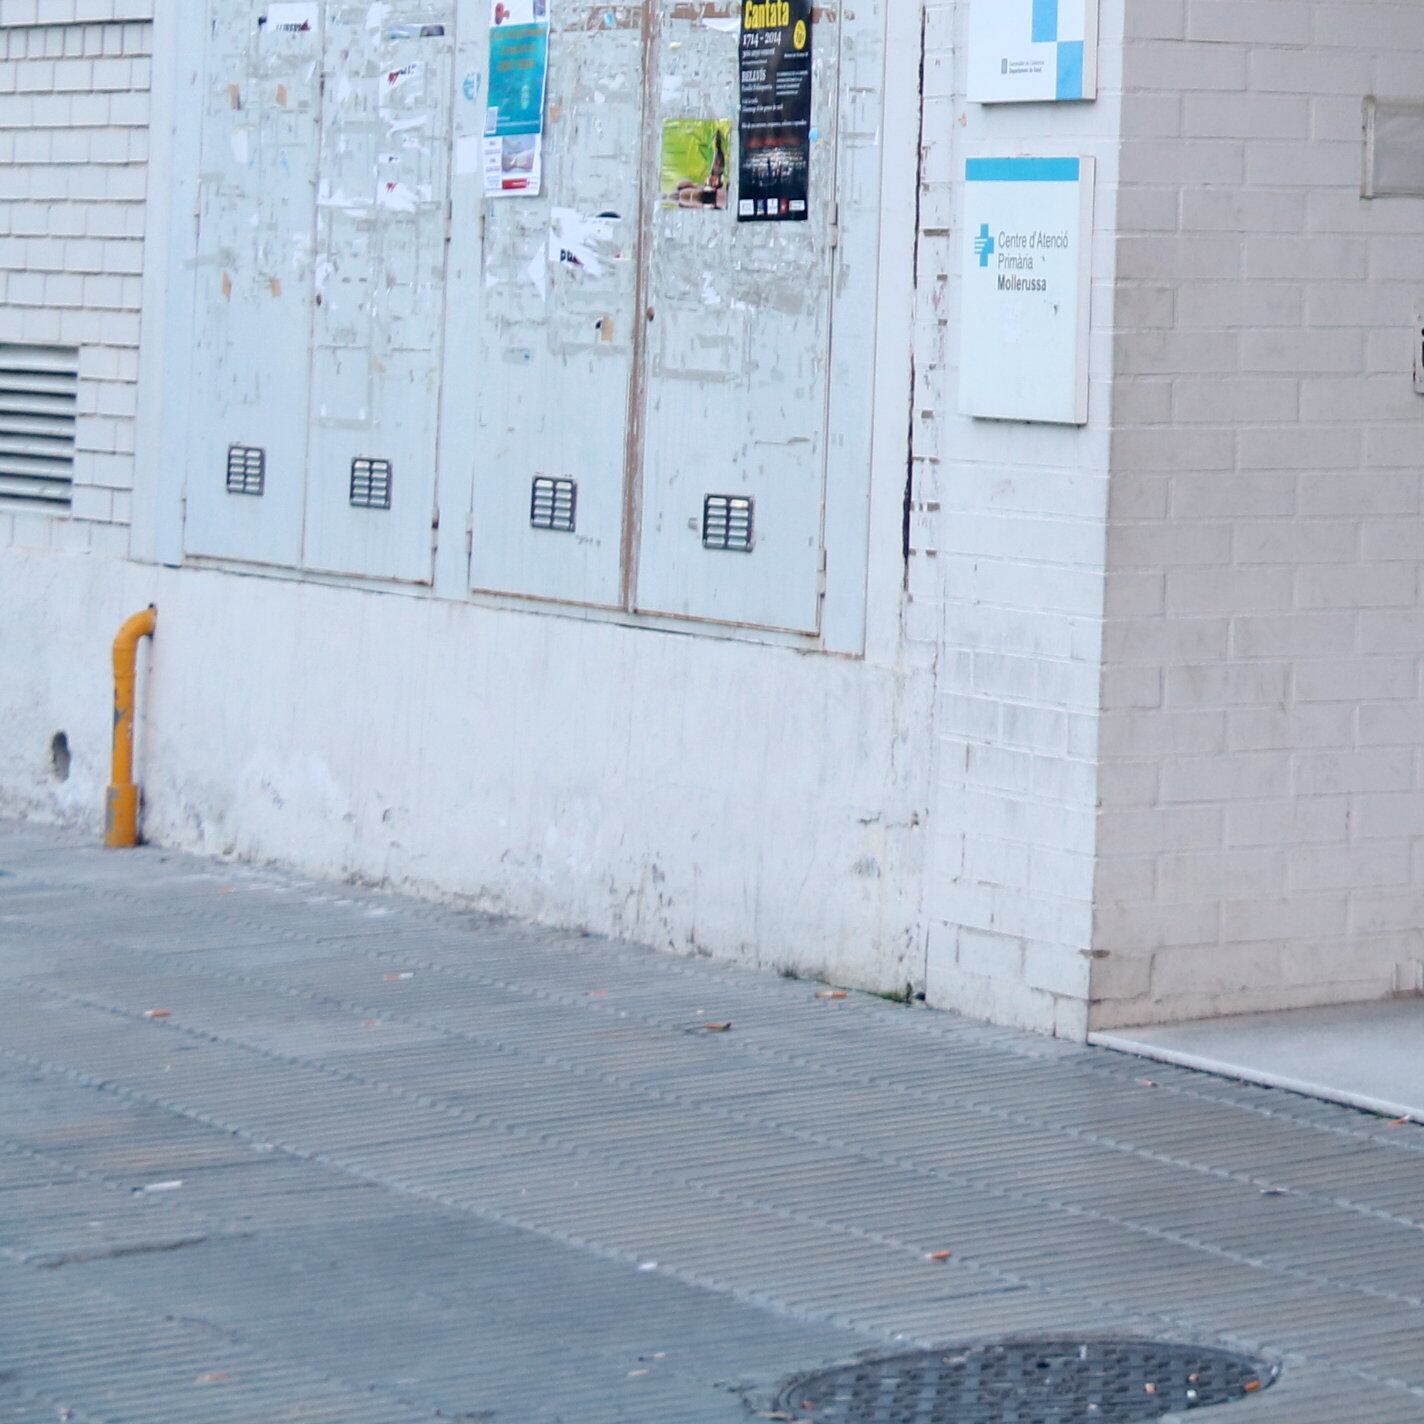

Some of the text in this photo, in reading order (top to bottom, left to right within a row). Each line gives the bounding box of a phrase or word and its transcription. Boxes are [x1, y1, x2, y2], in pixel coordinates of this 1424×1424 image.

[743, 33, 759, 48] 1714
[764, 31, 782, 46] 2014
[998, 230, 1069, 249] Centre d'Atenció
[998, 253, 1033, 270] Primària
[997, 274, 1047, 292] Mollerussa
